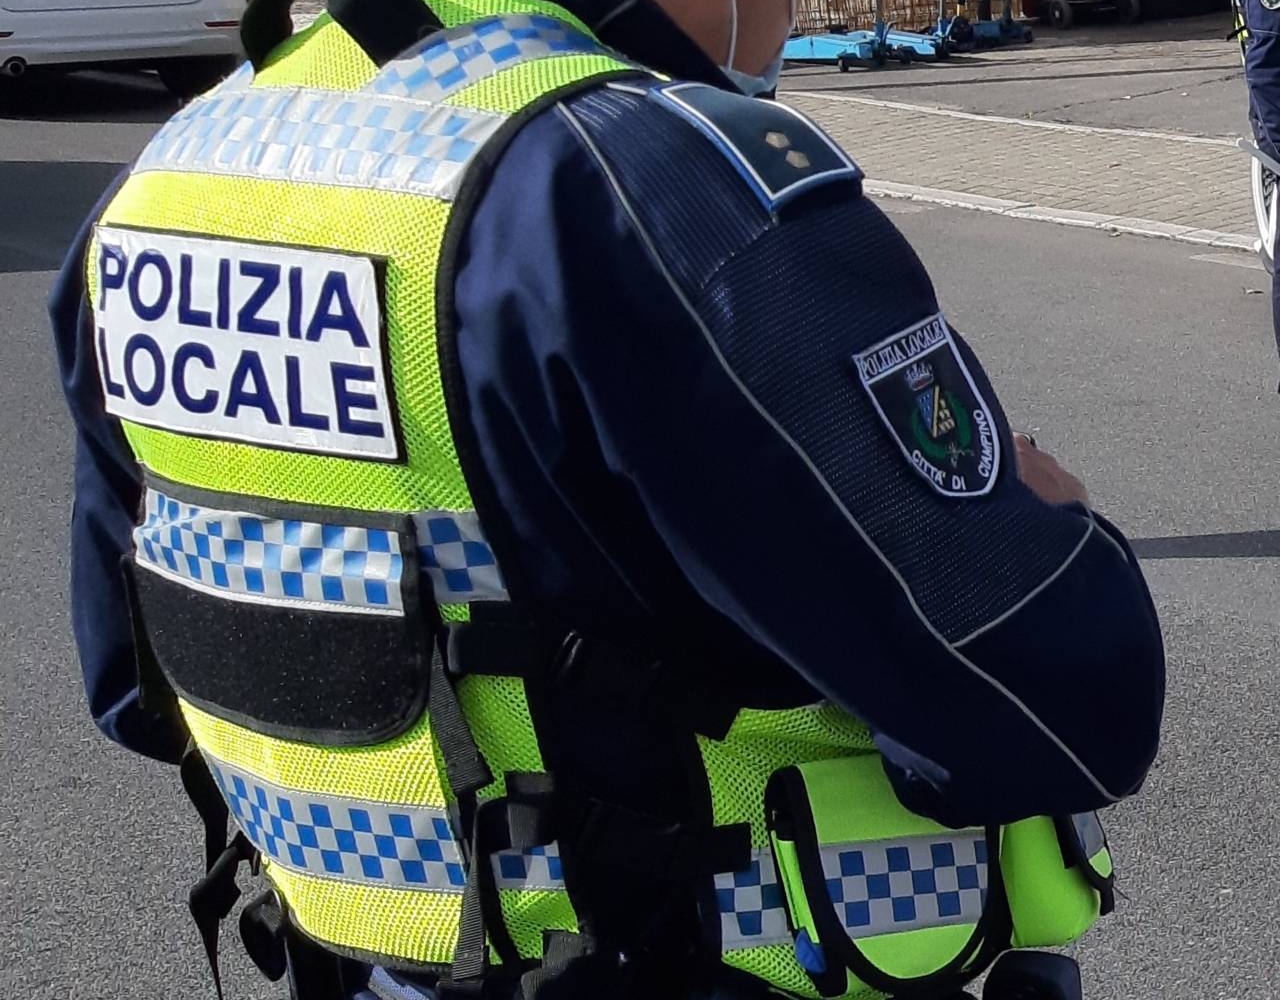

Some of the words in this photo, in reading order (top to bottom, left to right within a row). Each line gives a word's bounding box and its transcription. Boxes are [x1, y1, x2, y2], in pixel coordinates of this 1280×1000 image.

[100, 242, 372, 349] POLIZIA
[99, 327, 386, 439] LOCALE
[859, 345, 905, 380] POLIZIA
[901, 320, 945, 360] LOCALE
[951, 475, 967, 490] DI
[972, 409, 994, 478] CIAMPINO
